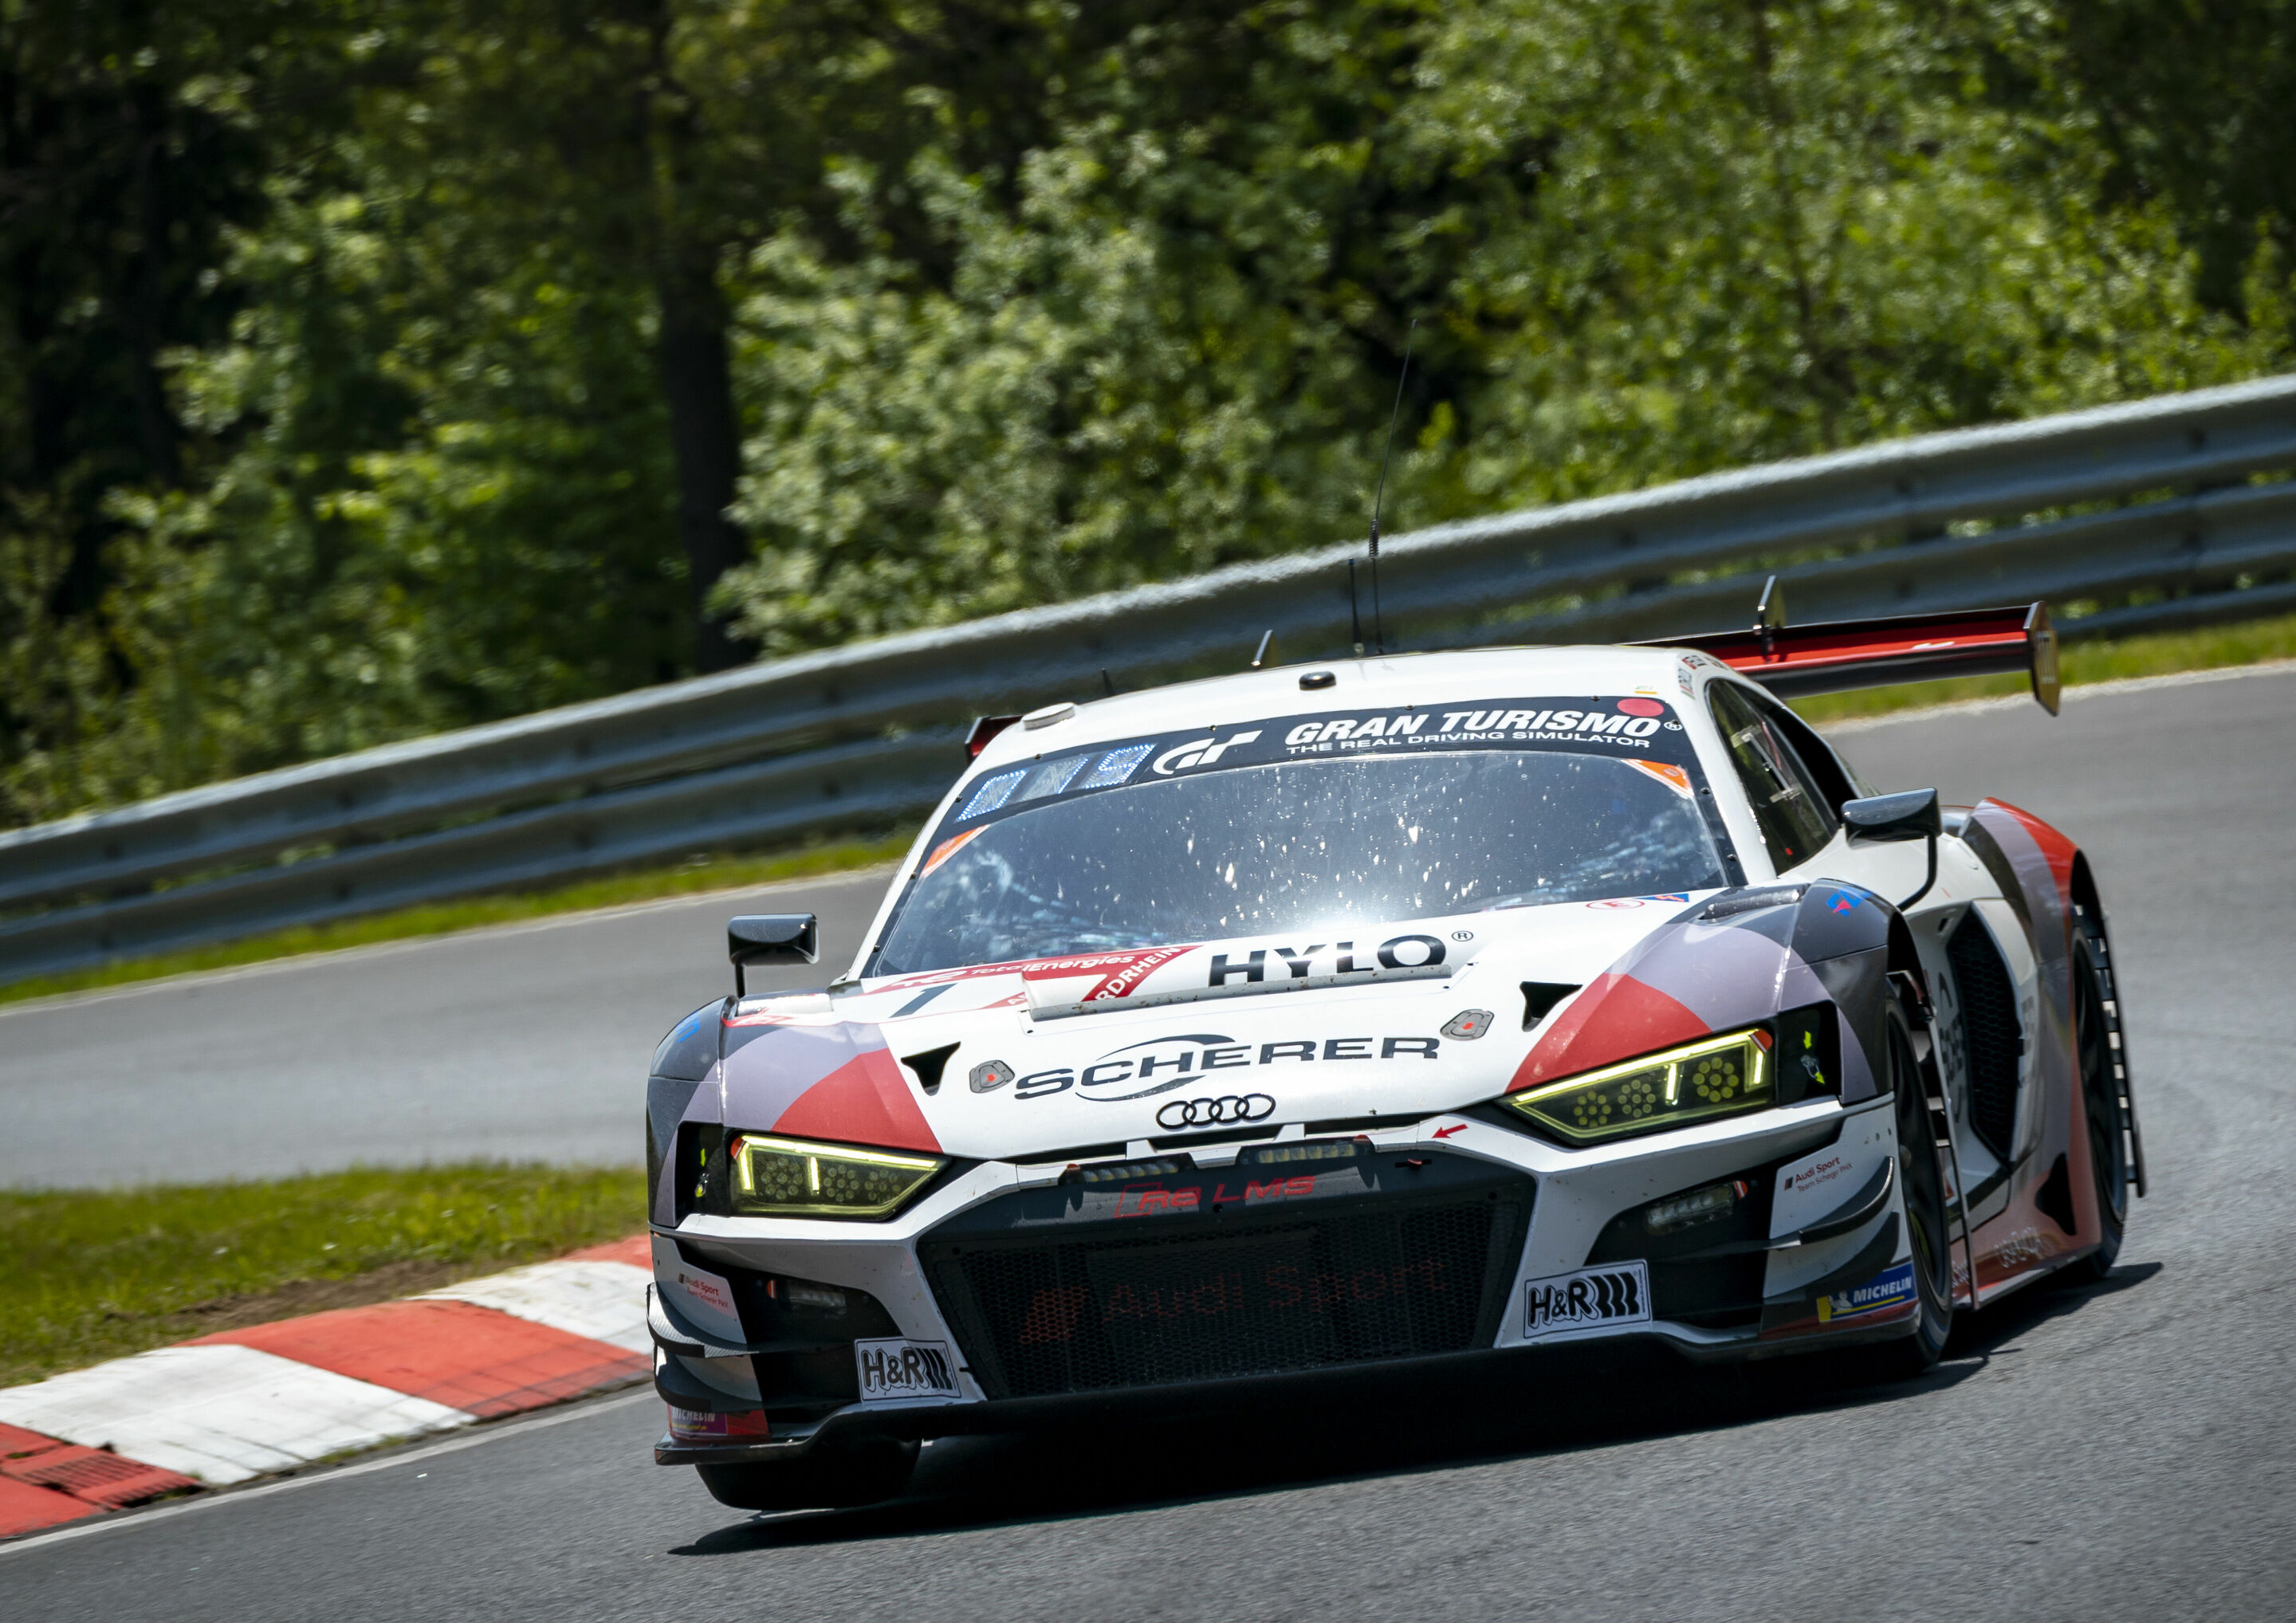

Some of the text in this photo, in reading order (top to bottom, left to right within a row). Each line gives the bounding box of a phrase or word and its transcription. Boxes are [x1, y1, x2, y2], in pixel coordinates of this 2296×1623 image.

[1284, 713, 1429, 745] GRAN
[1439, 709, 1661, 737] TURISMO
[1286, 731, 1650, 755] THE REAL DRIVING SIMULATOR
[1209, 934, 1446, 987] HYLO
[1014, 1035, 1440, 1100] SCHERER
[1795, 1157, 1840, 1183] Audi Sport
[1212, 1176, 1316, 1203] LMS
[700, 1281, 719, 1296] Sport
[1529, 1279, 1596, 1326] H&R
[1854, 1276, 1912, 1303] MICHELIN
[863, 1348, 926, 1390] H&R
